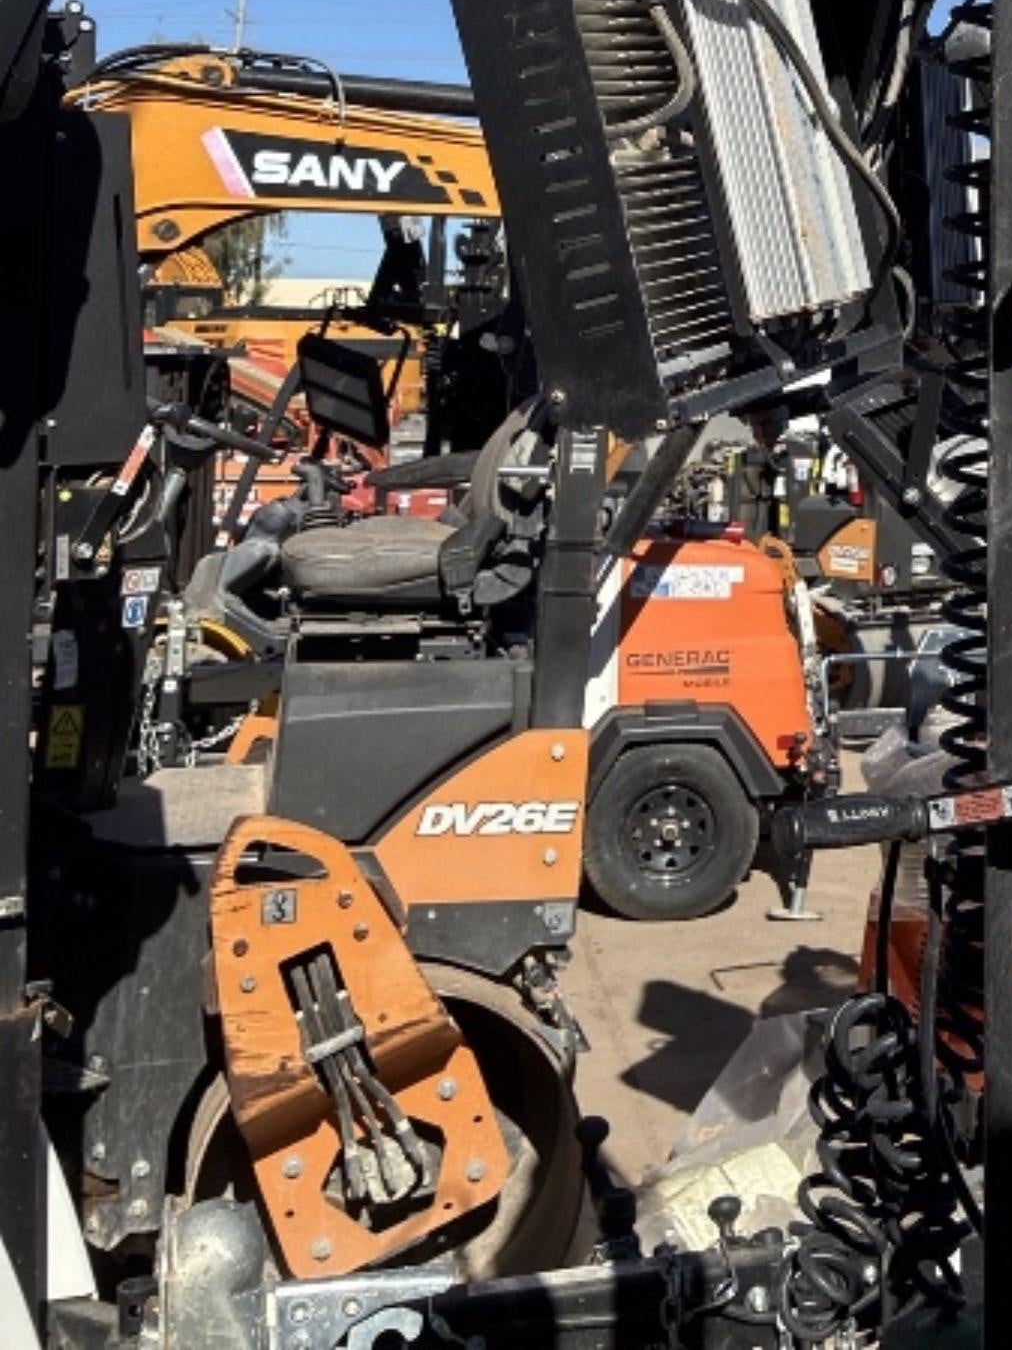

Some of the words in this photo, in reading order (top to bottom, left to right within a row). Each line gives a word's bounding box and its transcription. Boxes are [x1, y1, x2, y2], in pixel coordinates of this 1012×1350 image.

[252, 150, 406, 193] SANY
[626, 650, 730, 667] GENERAC
[415, 801, 582, 836] DV26E
